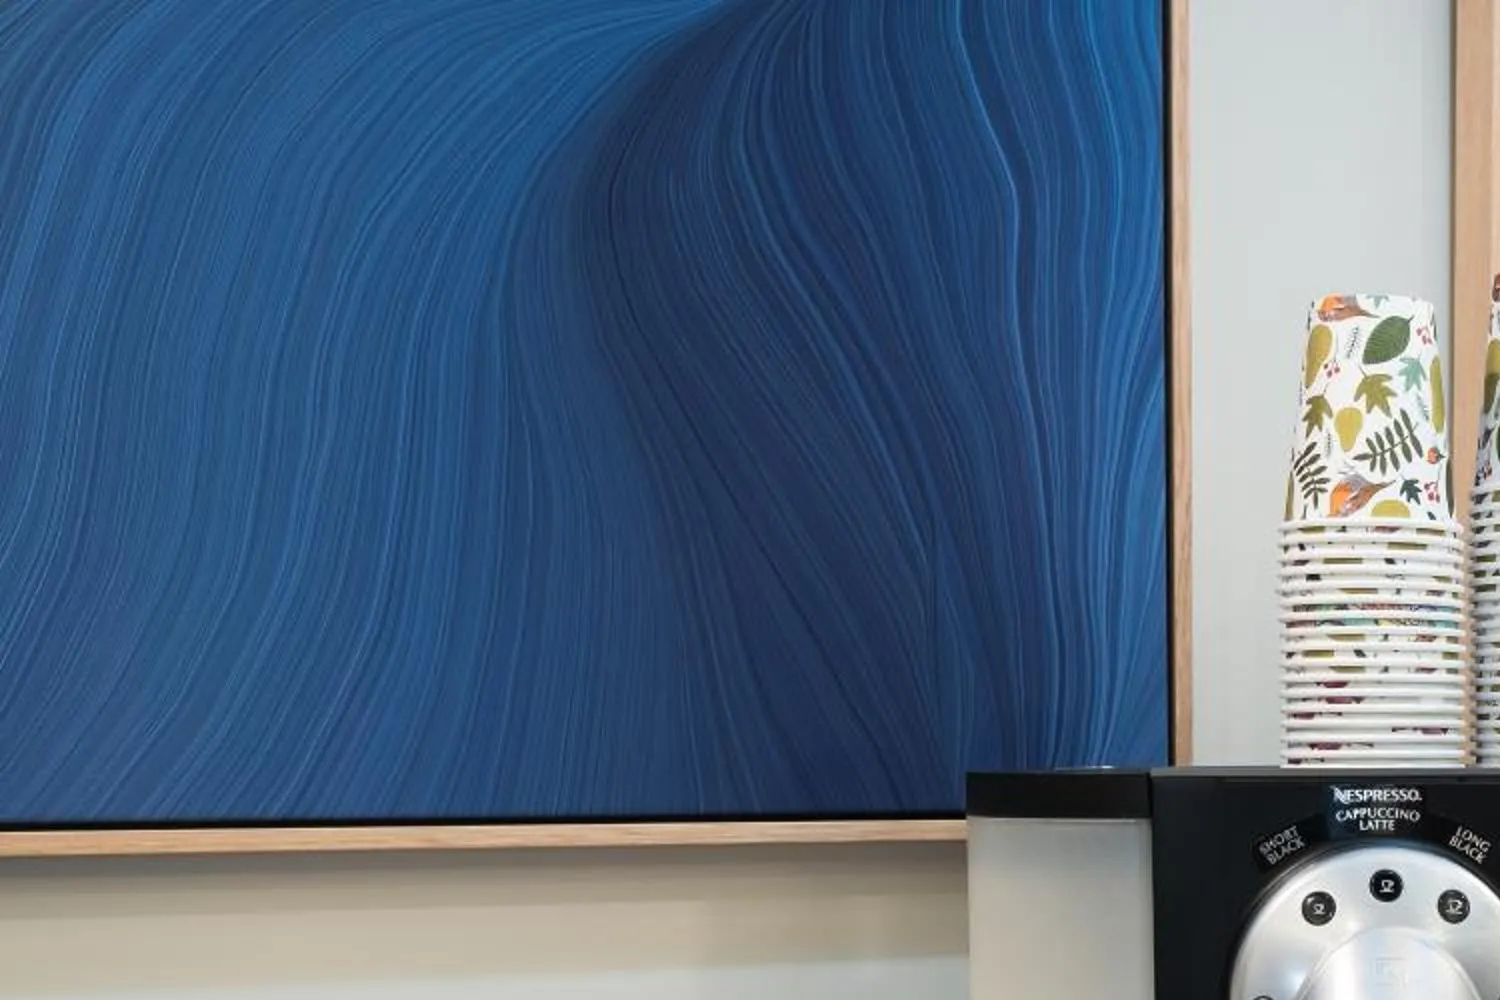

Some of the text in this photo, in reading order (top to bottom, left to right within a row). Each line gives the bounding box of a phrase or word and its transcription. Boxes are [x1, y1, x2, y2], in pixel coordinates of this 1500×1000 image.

[1335, 807, 1421, 822] CAPPUCCINO
[1359, 819, 1396, 831] LATTE
[1259, 825, 1299, 853] SHORT
[1266, 836, 1306, 865] BLACK
[1449, 836, 1487, 864] BLACK
[1455, 825, 1492, 853] LONG
